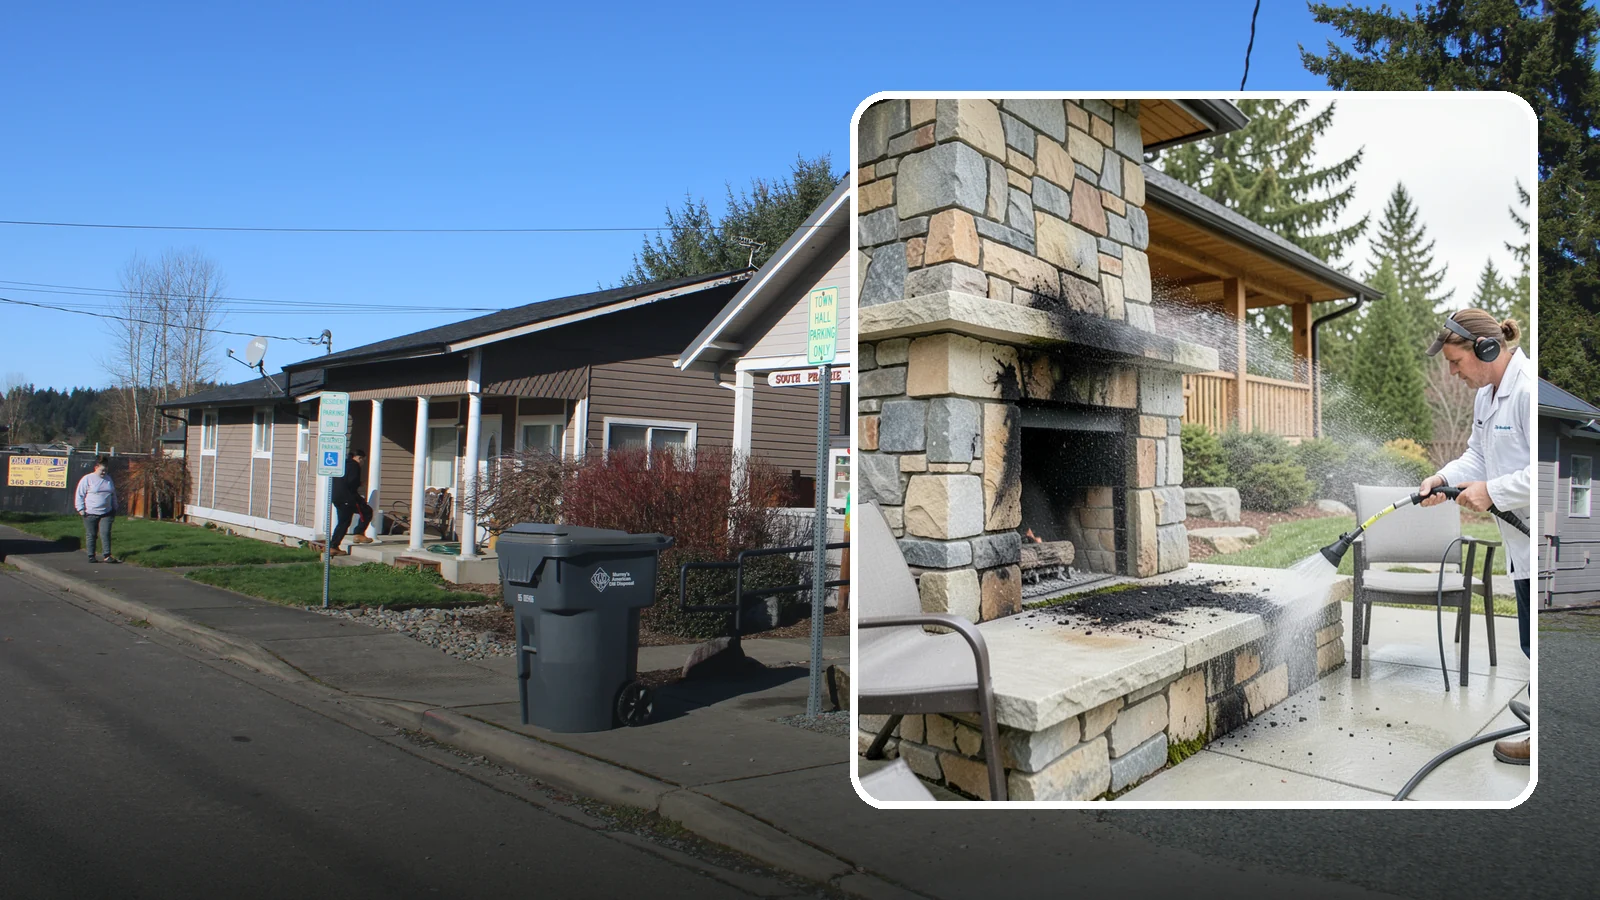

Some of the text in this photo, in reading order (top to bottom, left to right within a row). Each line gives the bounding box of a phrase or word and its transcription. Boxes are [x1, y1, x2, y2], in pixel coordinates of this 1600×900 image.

[815, 294, 832, 308] TOWN
[814, 312, 830, 324] HALL
[810, 327, 836, 340] PARKING
[814, 344, 830, 357] ONLY
[776, 374, 800, 384] SOUTH
